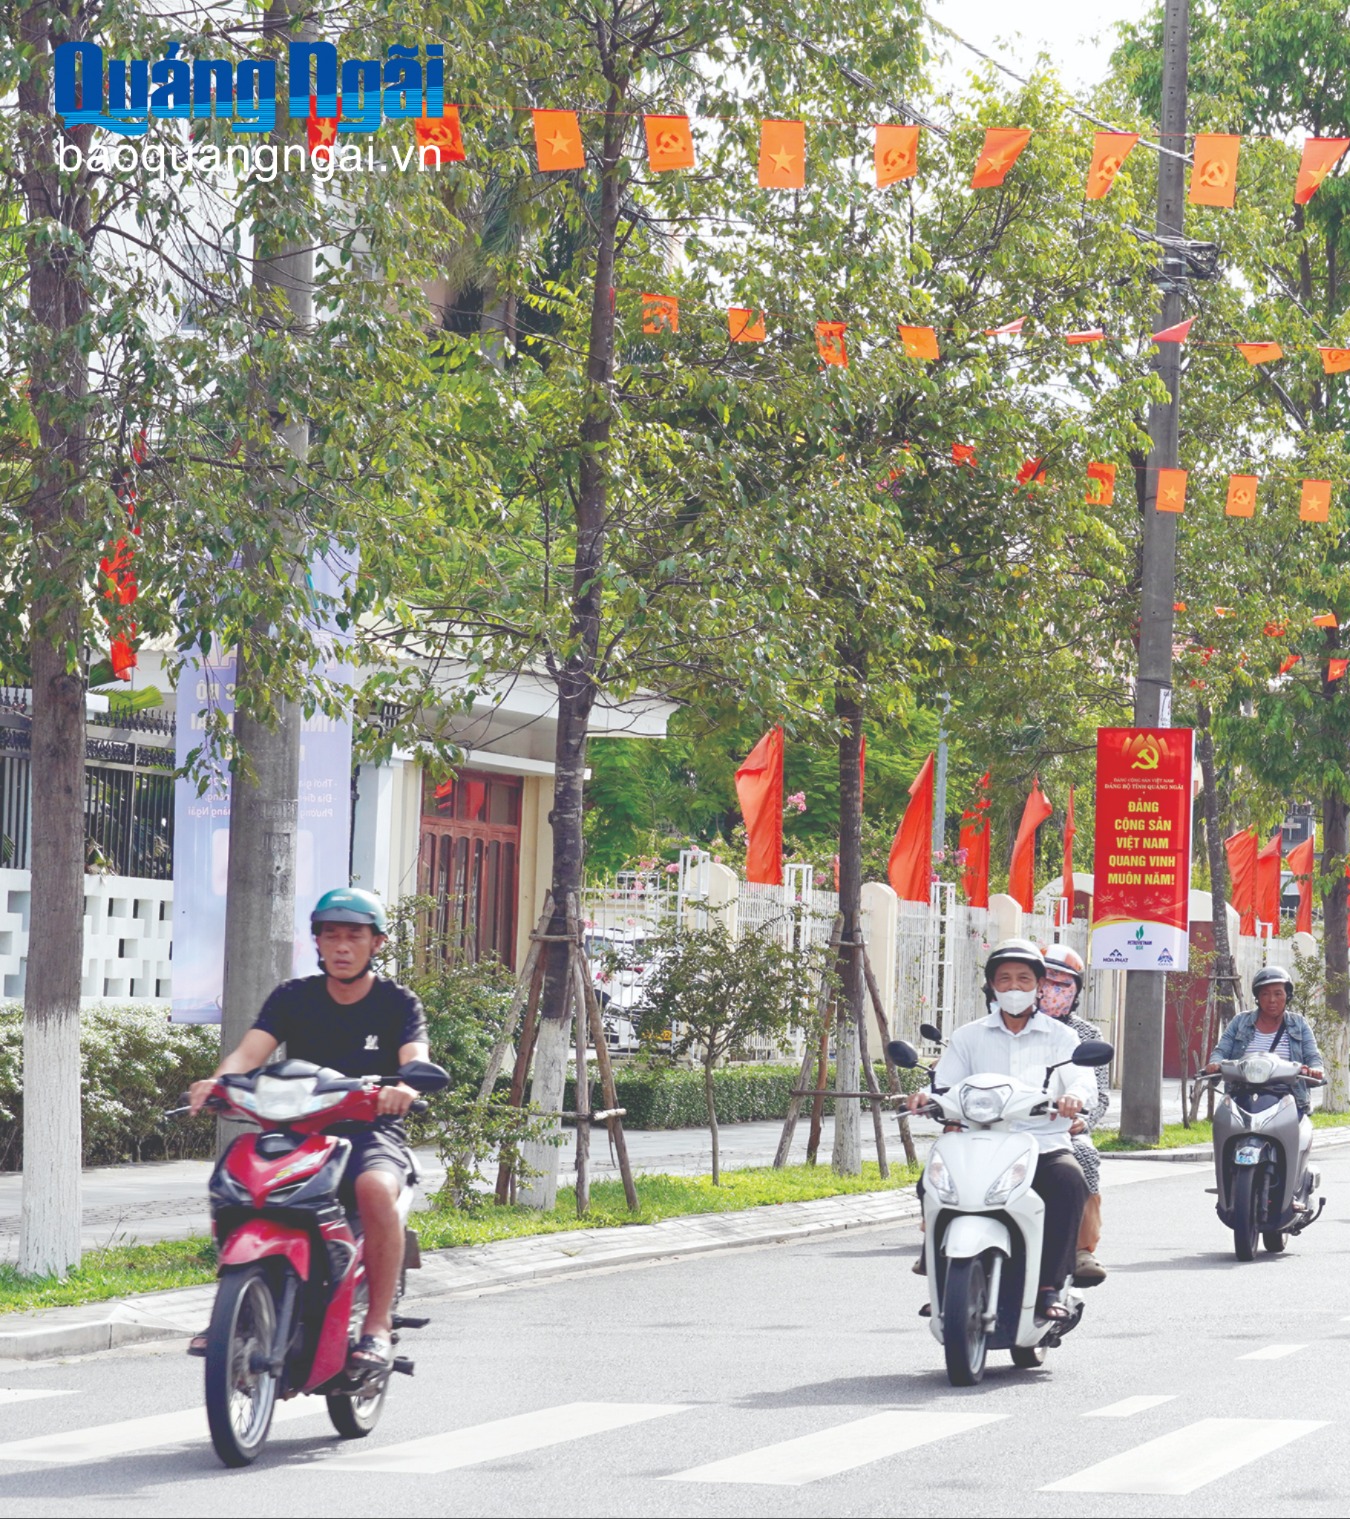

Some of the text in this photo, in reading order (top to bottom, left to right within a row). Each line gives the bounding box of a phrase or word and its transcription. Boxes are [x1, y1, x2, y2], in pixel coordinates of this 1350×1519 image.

[1128, 798, 1159, 813] ĐẢNG
[1114, 815, 1172, 834] CỘNG SẢN
[1116, 835, 1169, 852] VIỆT NAM
[1108, 855, 1175, 867] QUANG VINH
[1107, 869, 1175, 885] MUÔN NĂM!
